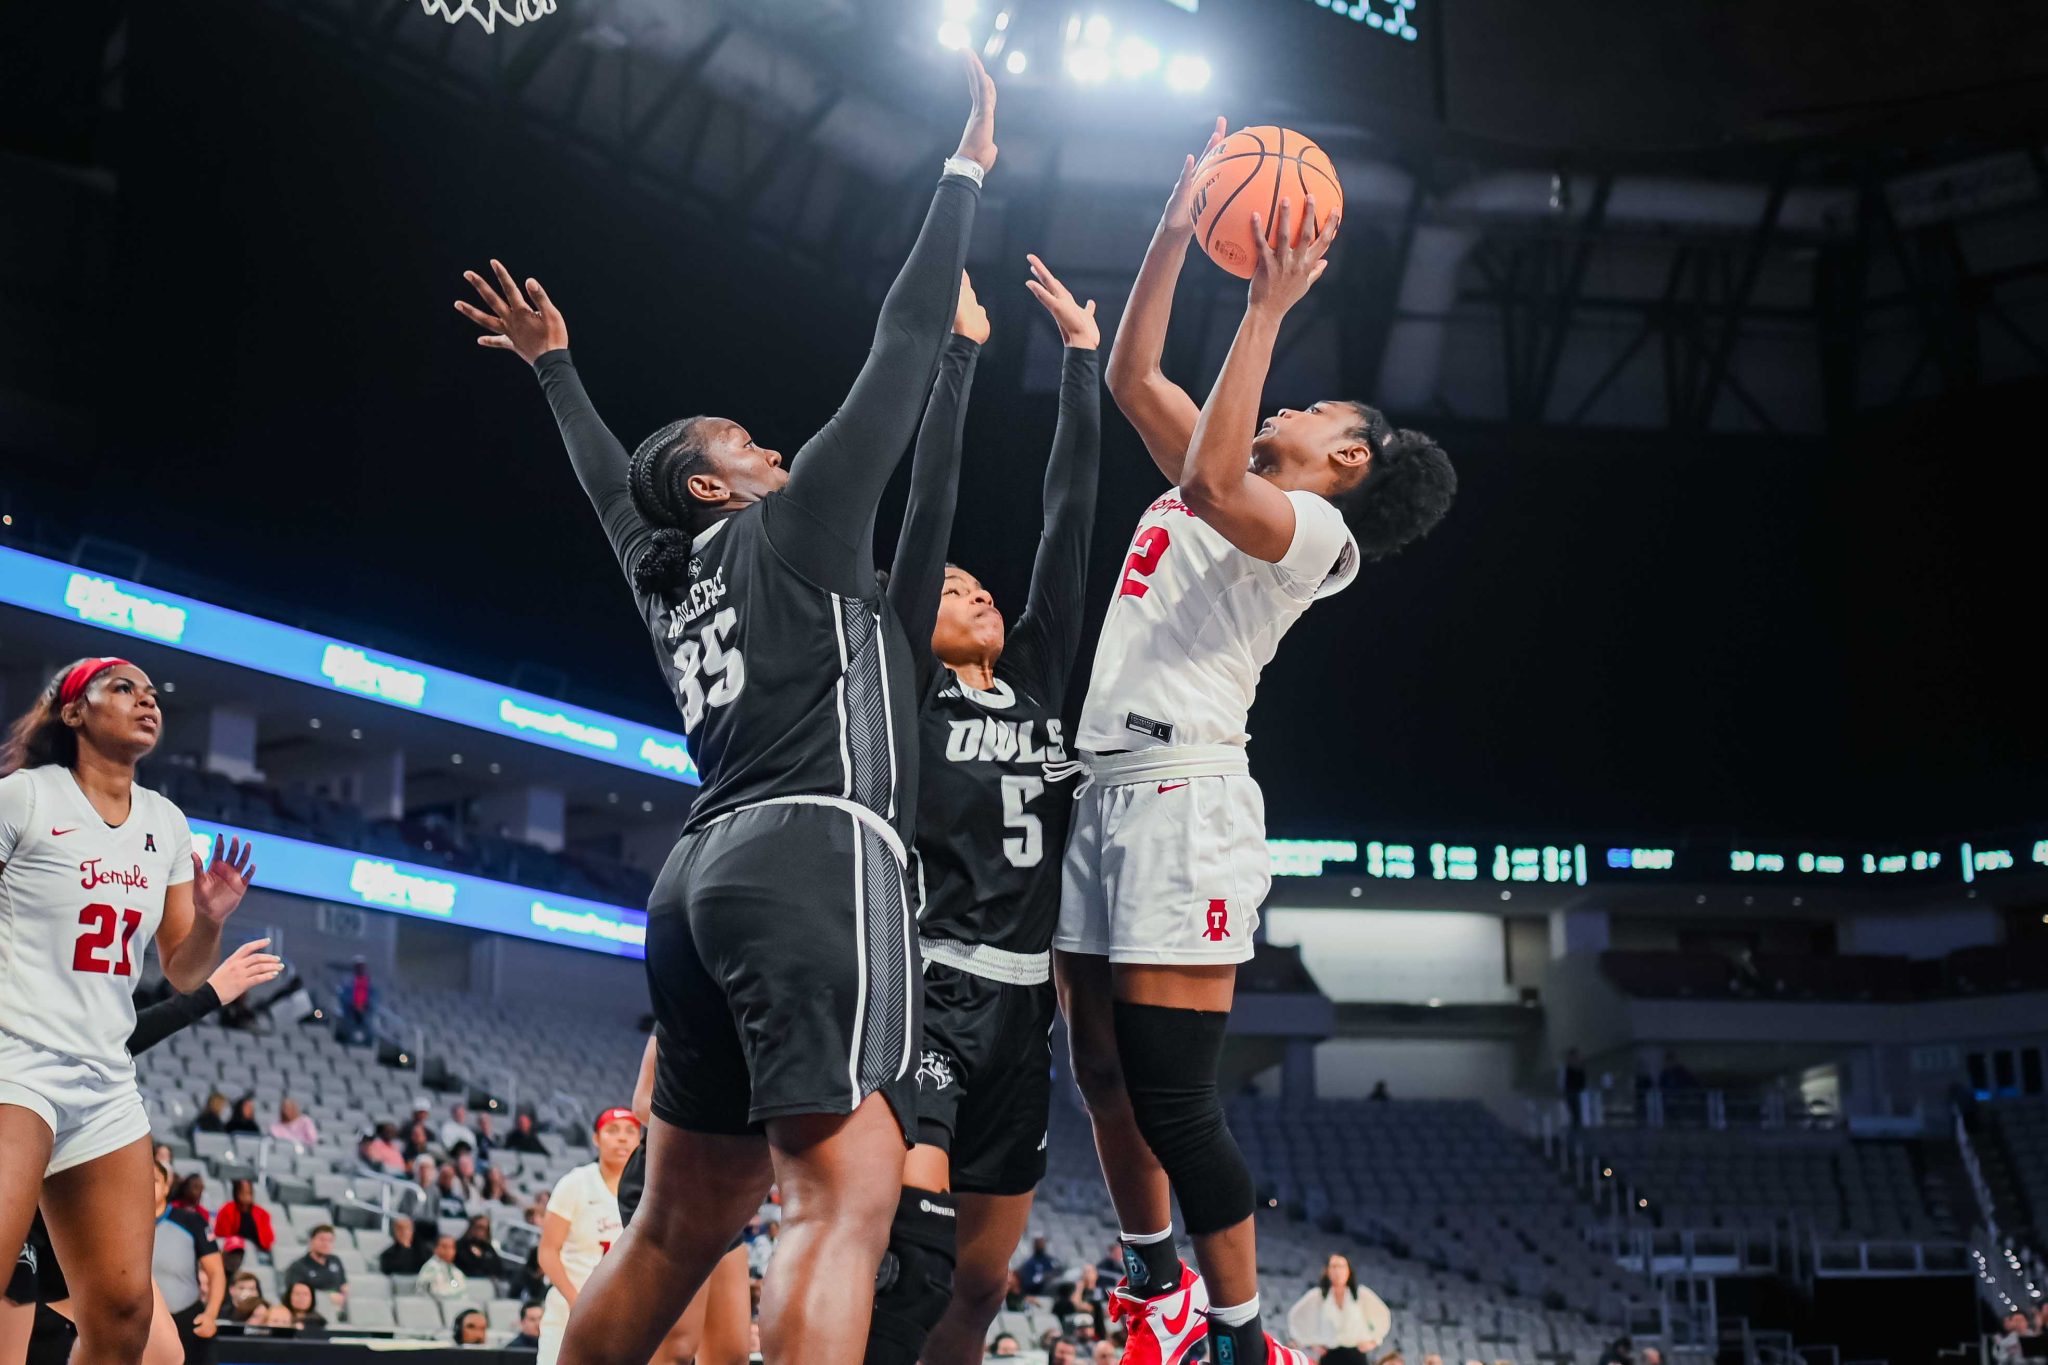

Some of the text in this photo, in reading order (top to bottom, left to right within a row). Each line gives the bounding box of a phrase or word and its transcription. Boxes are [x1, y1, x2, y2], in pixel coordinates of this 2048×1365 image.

[673, 607, 745, 735] 35
[946, 716, 1067, 763] OWLS
[1001, 775, 1045, 867] 5
[80, 858, 148, 893] Temple
[73, 903, 142, 976] 21
